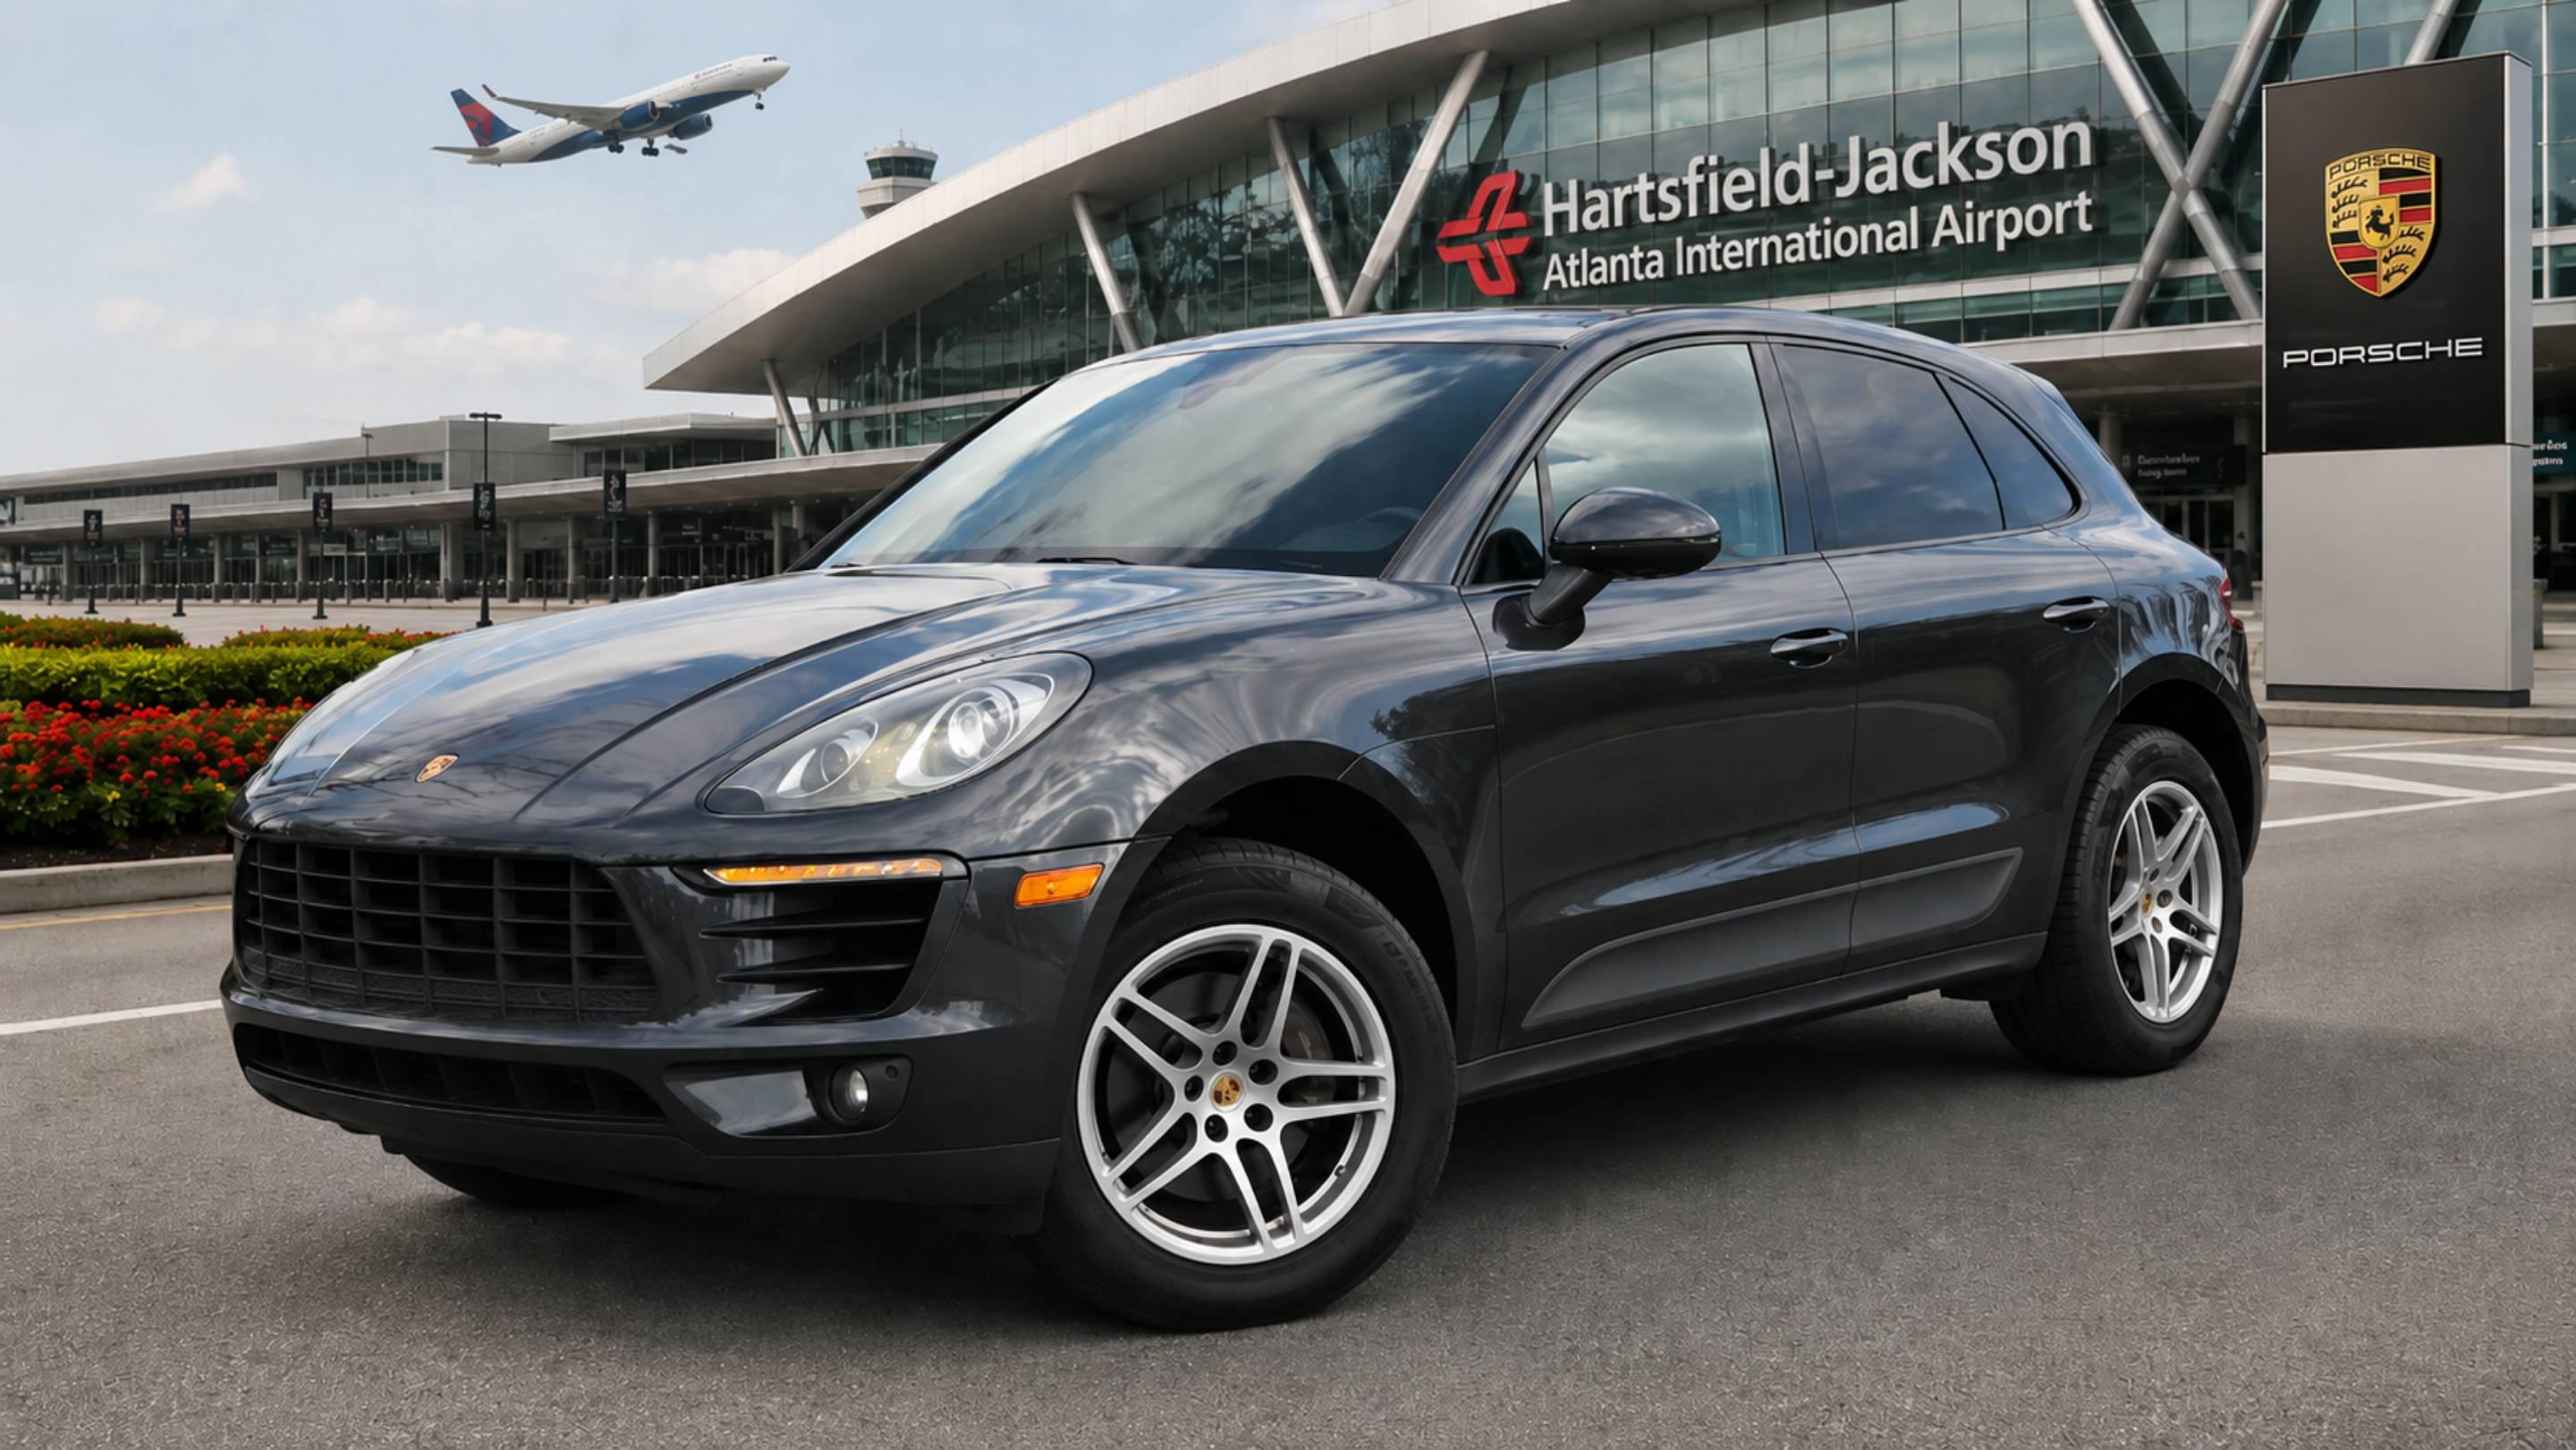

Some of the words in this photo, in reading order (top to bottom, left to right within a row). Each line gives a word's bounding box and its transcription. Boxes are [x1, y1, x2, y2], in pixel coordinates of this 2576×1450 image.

[1544, 120, 2094, 237] Hartsfield-Jackson
[2329, 153, 2432, 180] PORSCHE
[1543, 243, 1665, 291] Atlanta
[1675, 214, 1919, 276] International
[1930, 191, 2094, 252] Airport
[2283, 336, 2483, 369] PORSCHE
